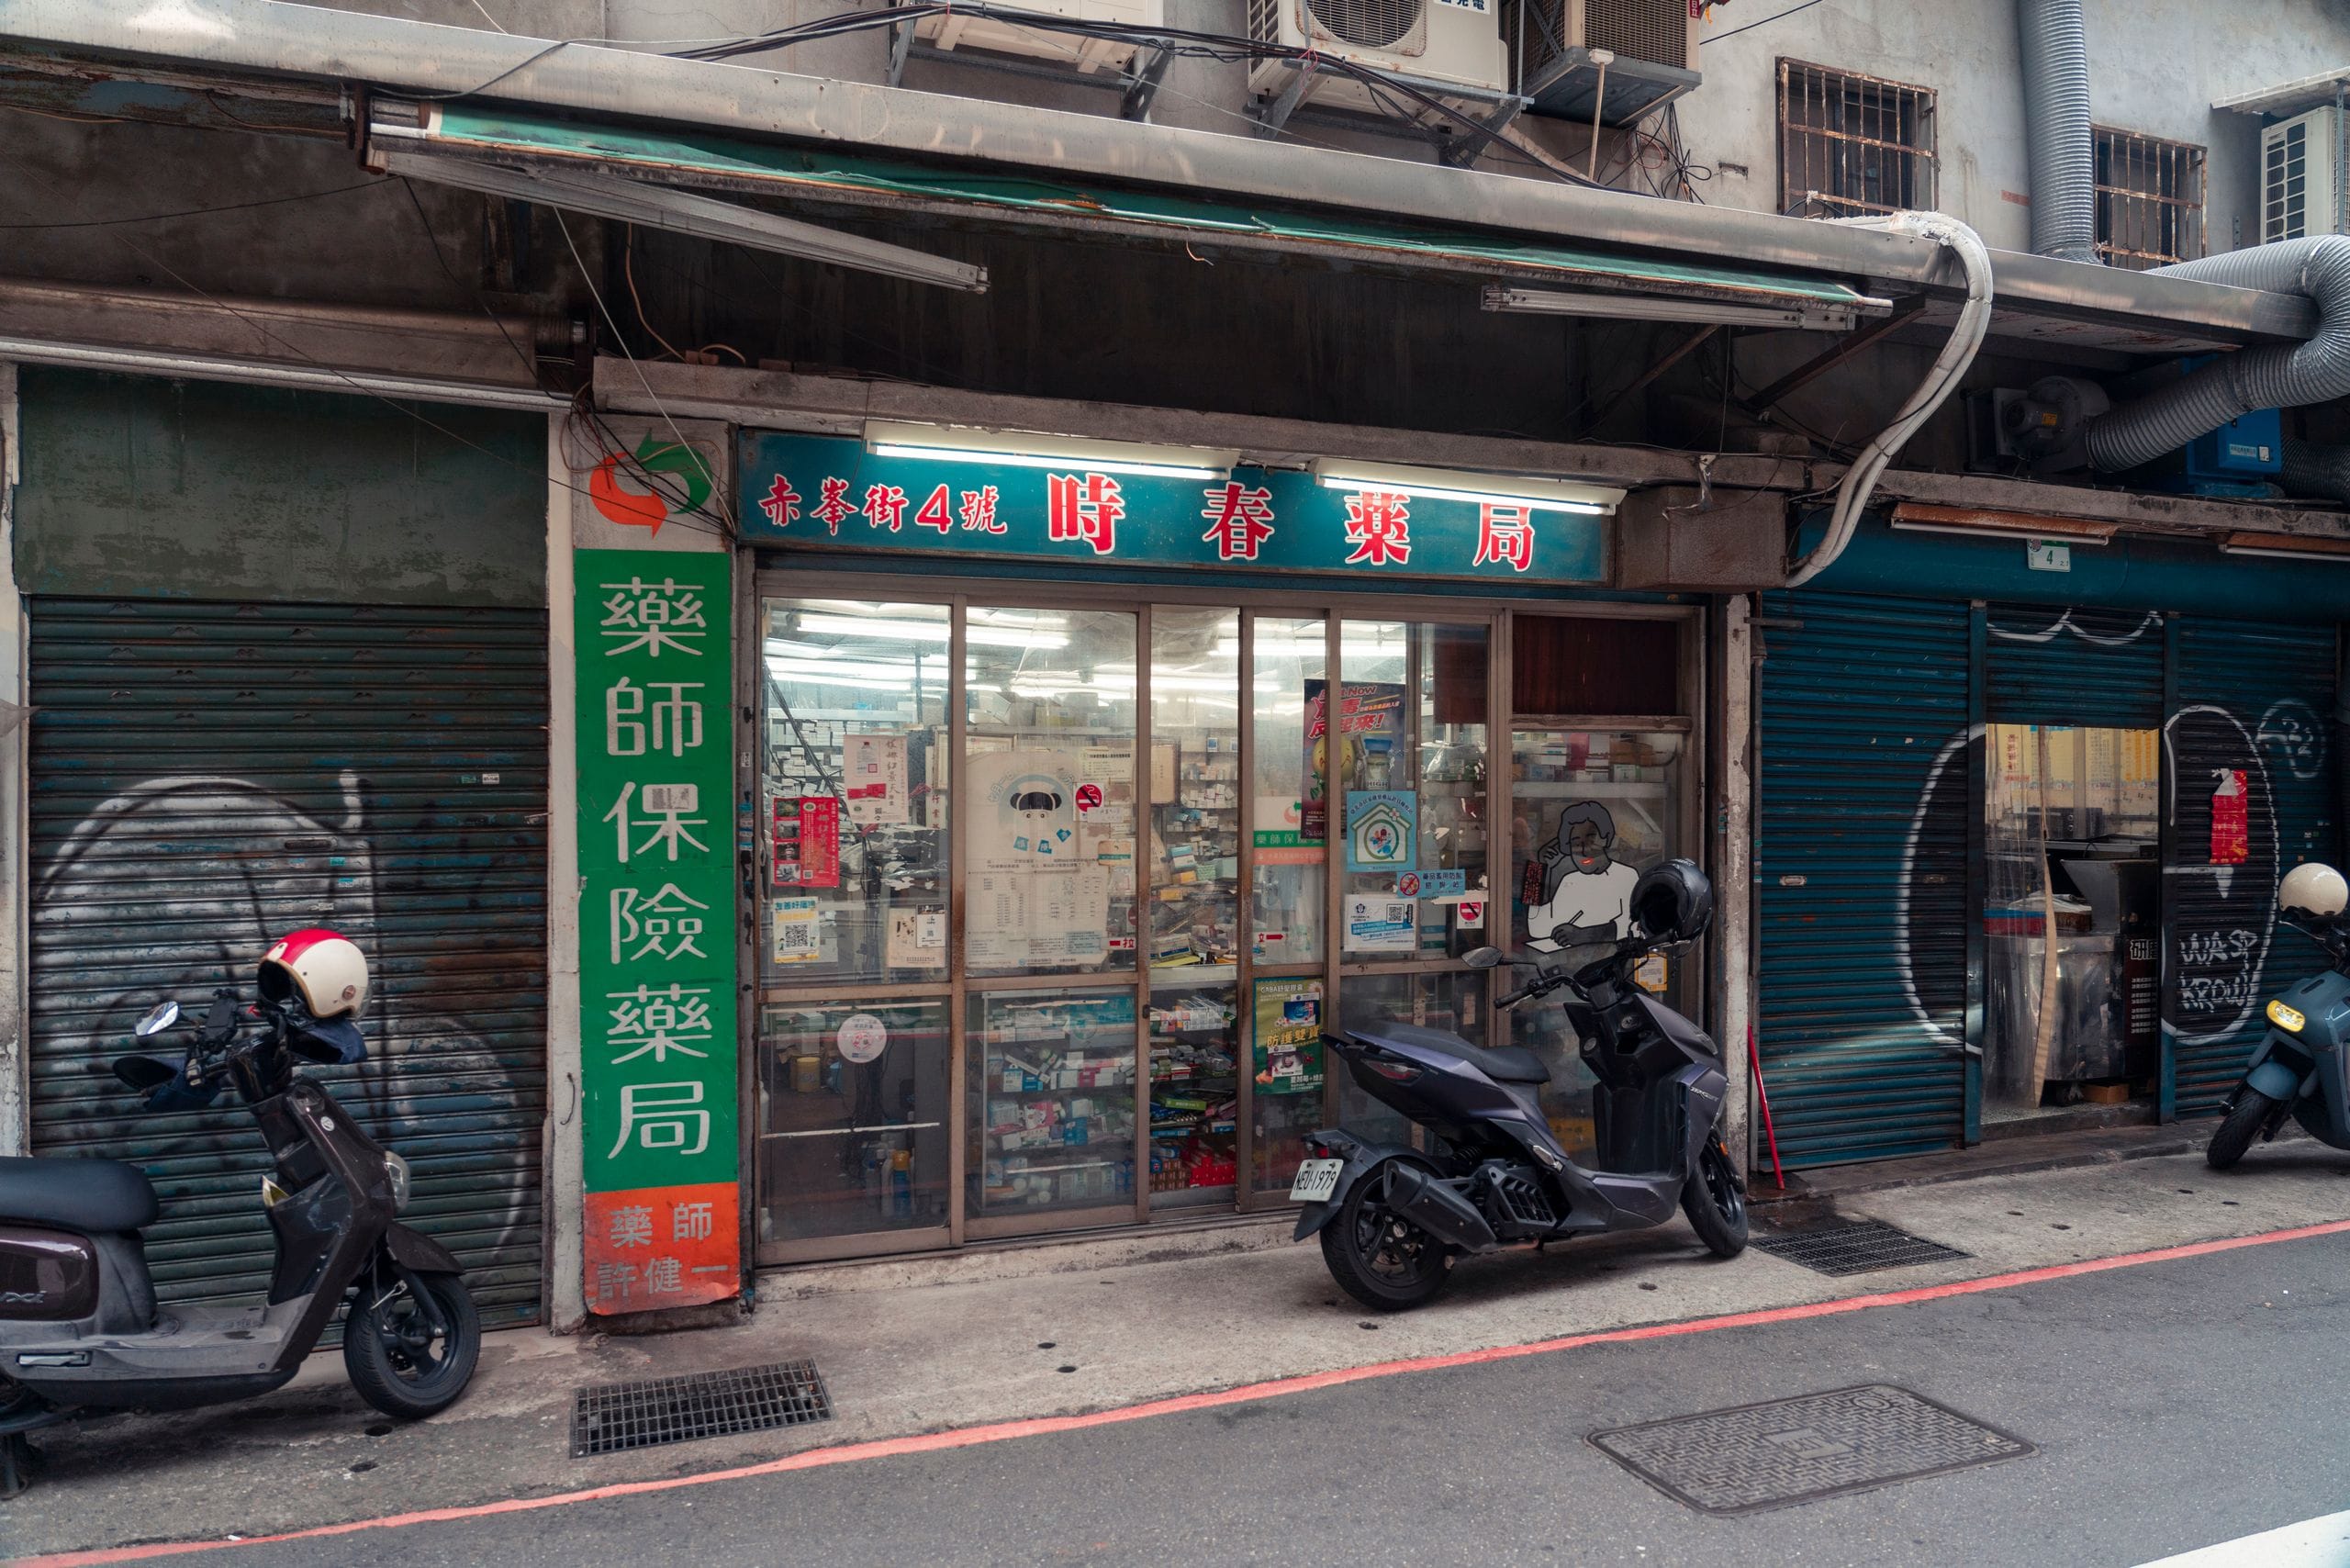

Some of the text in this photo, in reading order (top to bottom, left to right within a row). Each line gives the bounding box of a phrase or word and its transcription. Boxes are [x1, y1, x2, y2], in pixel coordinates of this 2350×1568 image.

[2046, 551, 2053, 565] 4
[599, 576, 713, 1159] 藥師保險藥局
[1123, 939, 1135, 948] 拉
[610, 1202, 713, 1249] 藥師
[597, 1256, 729, 1300] 許健一
